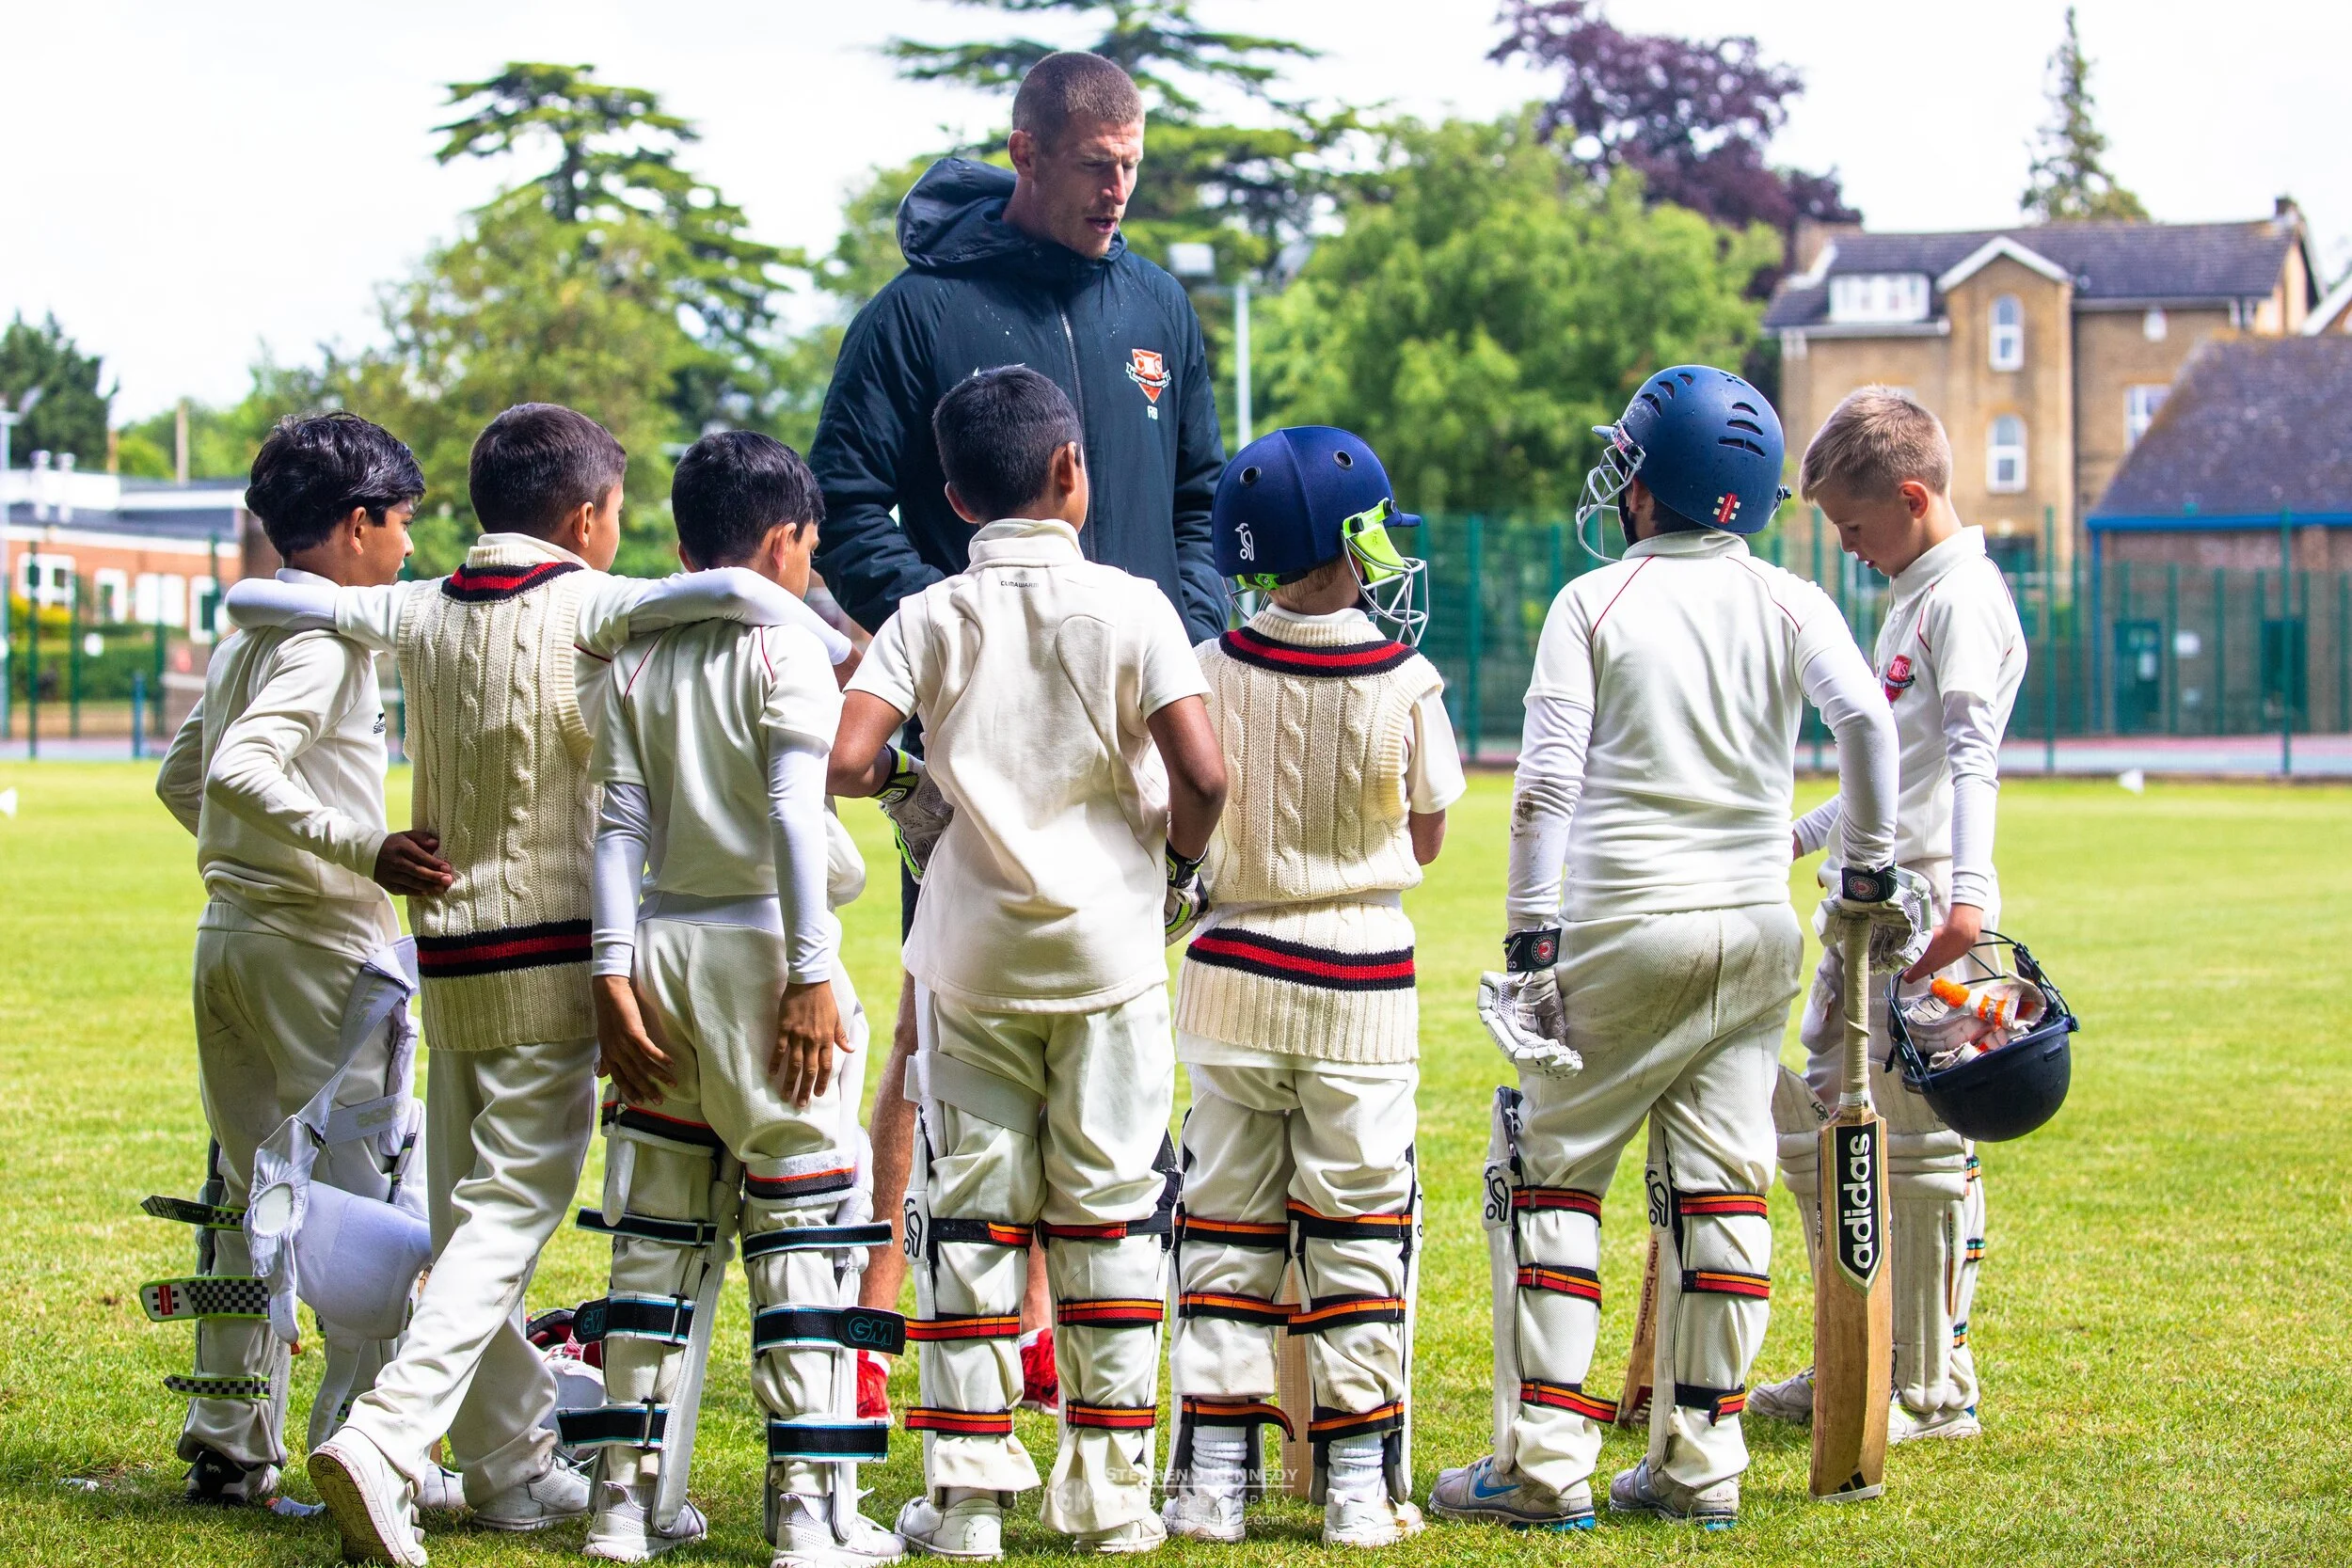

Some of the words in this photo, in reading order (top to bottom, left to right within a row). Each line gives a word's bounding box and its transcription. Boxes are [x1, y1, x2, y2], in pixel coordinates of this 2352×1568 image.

[1843, 1132, 1873, 1269] adidas
[1649, 1241, 1660, 1274] new
[580, 1307, 604, 1336] GM
[849, 1316, 894, 1346] GM
